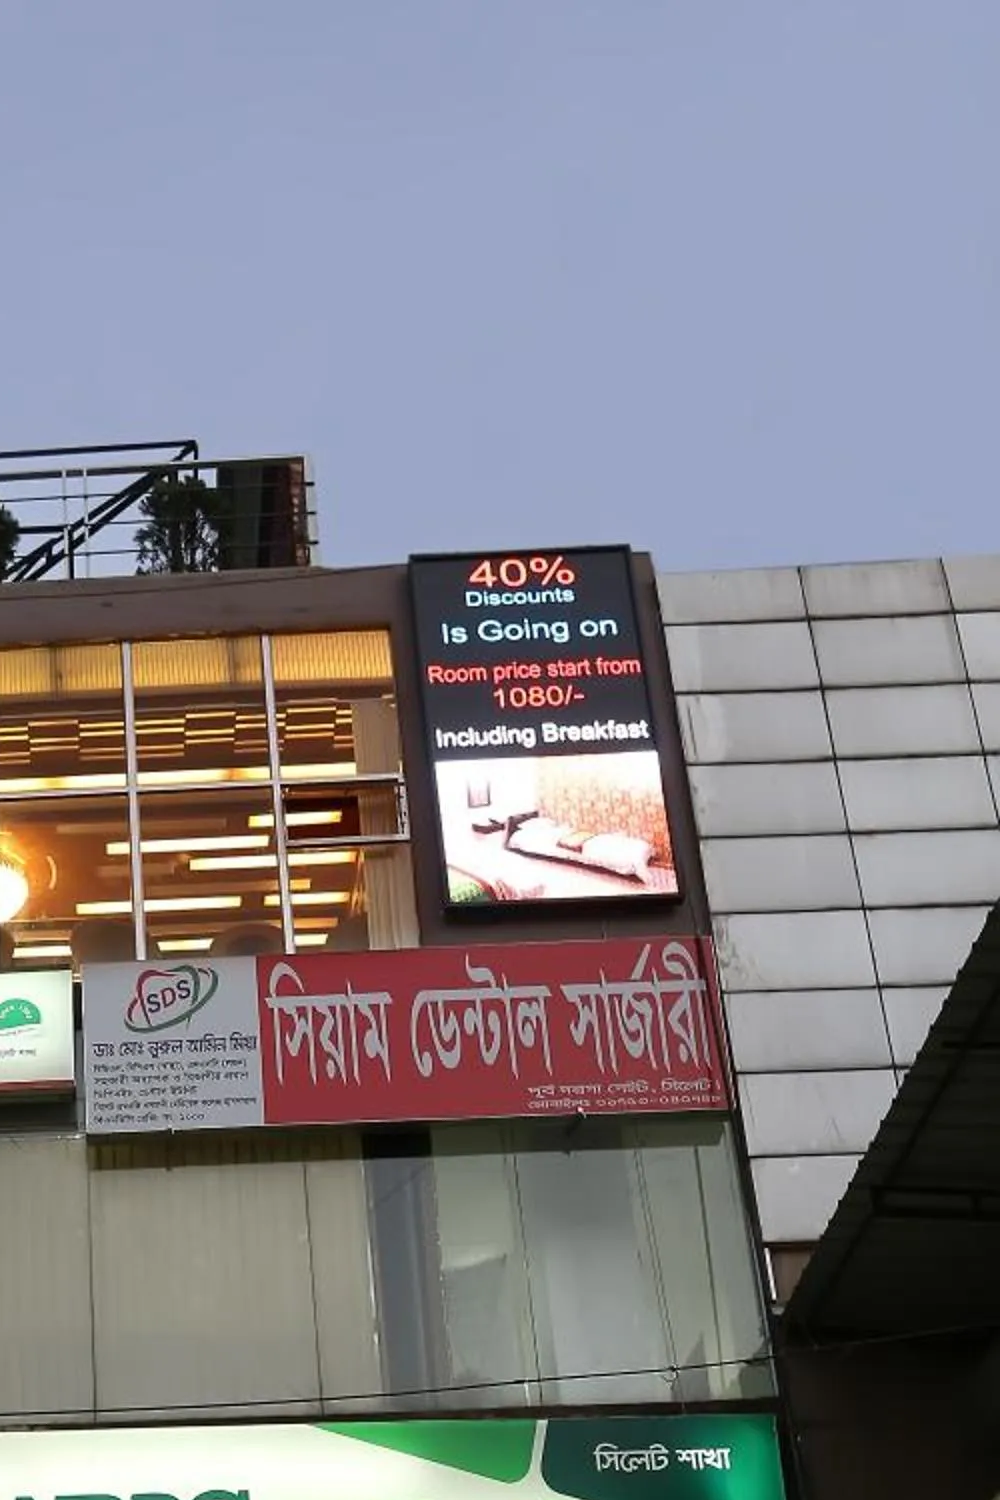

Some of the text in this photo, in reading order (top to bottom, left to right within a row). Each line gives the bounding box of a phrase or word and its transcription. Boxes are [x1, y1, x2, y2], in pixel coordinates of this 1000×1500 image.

[468, 556, 576, 589] 40%
[465, 587, 575, 607] Discounts
[442, 617, 618, 645] Is Going on
[427, 656, 642, 684] Room price start from
[493, 685, 585, 709] 1080/-
[435, 719, 650, 749] Including Breakfast
[147, 979, 191, 1014] SDS
[264, 942, 714, 1086] সিয়াম ডেন্টাল সার্জারী
[593, 1443, 731, 1473] সিলেট শাখা
